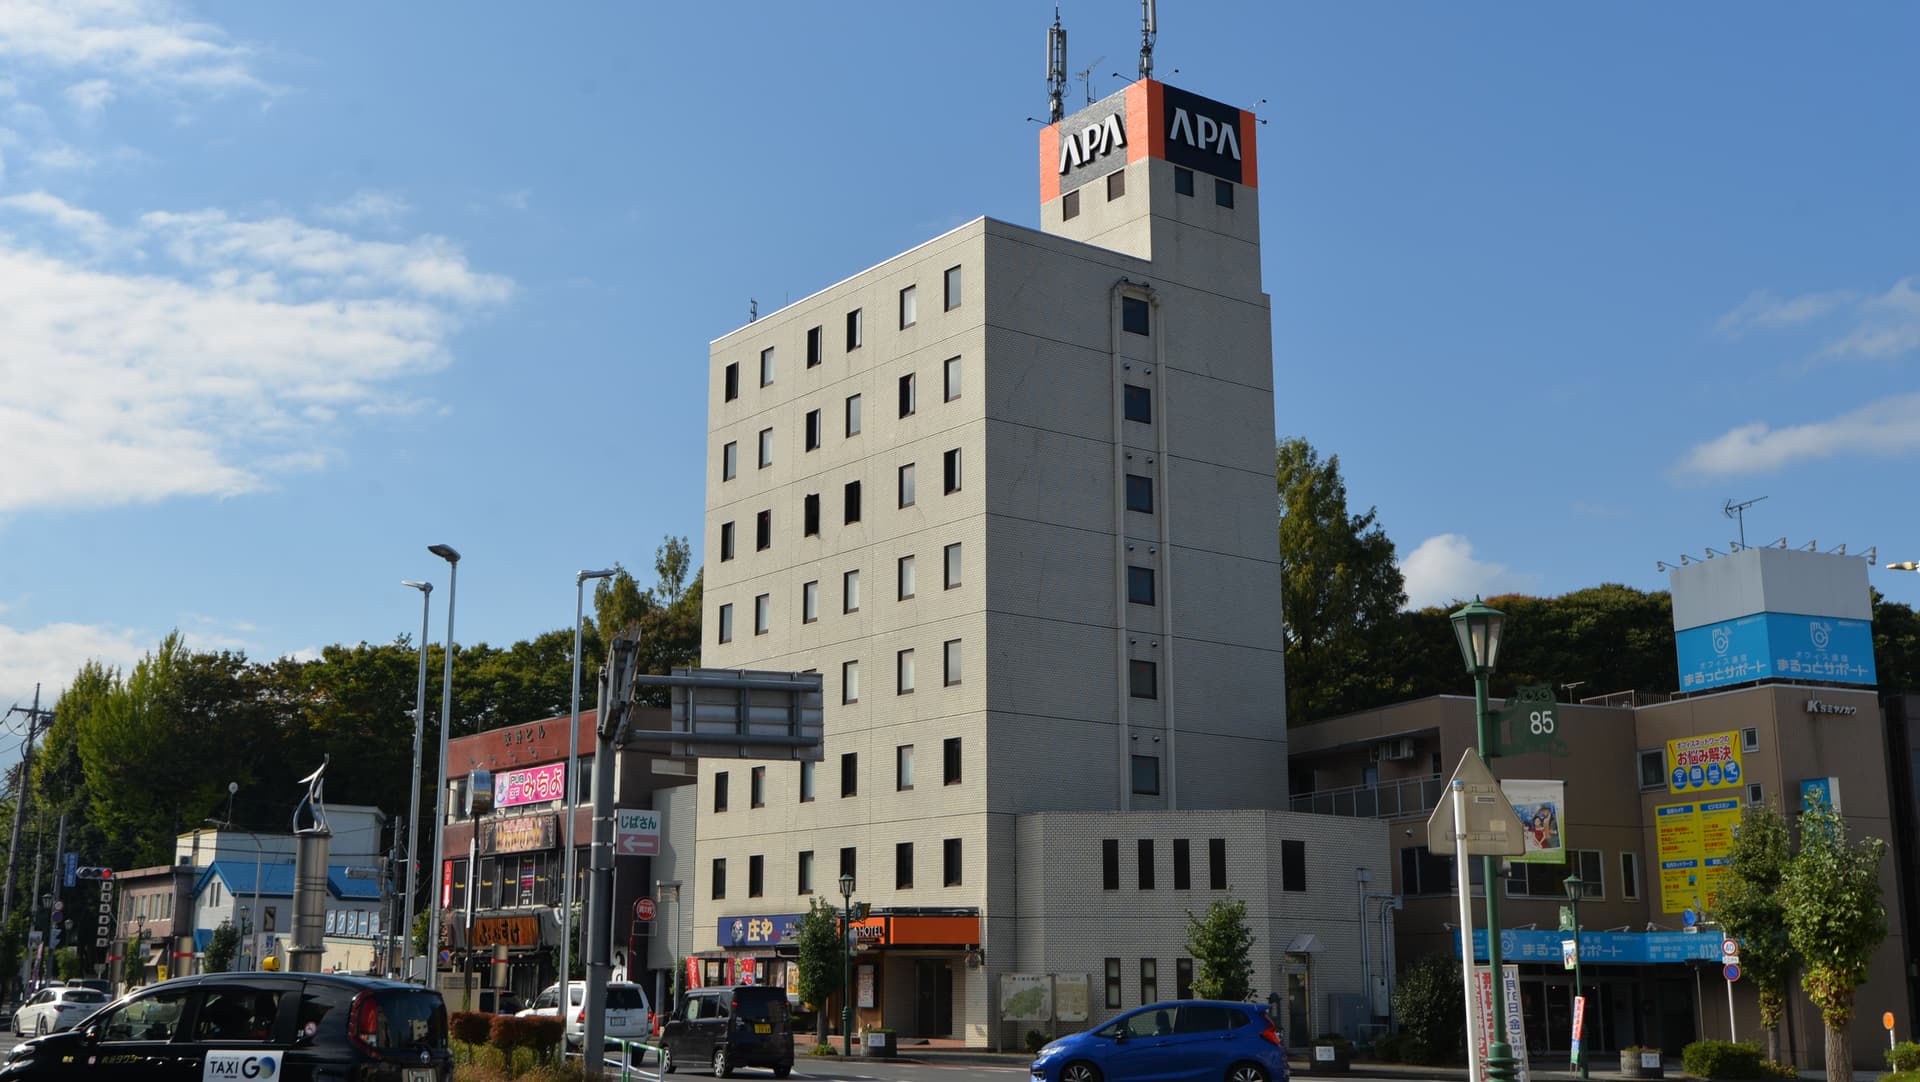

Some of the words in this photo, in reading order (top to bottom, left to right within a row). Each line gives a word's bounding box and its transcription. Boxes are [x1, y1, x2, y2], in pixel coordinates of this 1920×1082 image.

[1059, 113, 1123, 174] APA
[1170, 107, 1241, 160] APA
[1683, 660, 1767, 687] まるっとサポート
[1776, 658, 1869, 677] まるっとサポート
[1530, 711, 1554, 734] 85
[1678, 745, 1731, 766] お悩み解決
[510, 774, 524, 785] PUB
[523, 767, 563, 800] みちよ
[620, 815, 657, 829] じばさん
[747, 917, 773, 942] 庄や
[858, 925, 883, 937] HOTEL
[210, 1060, 239, 1074] TAXI
